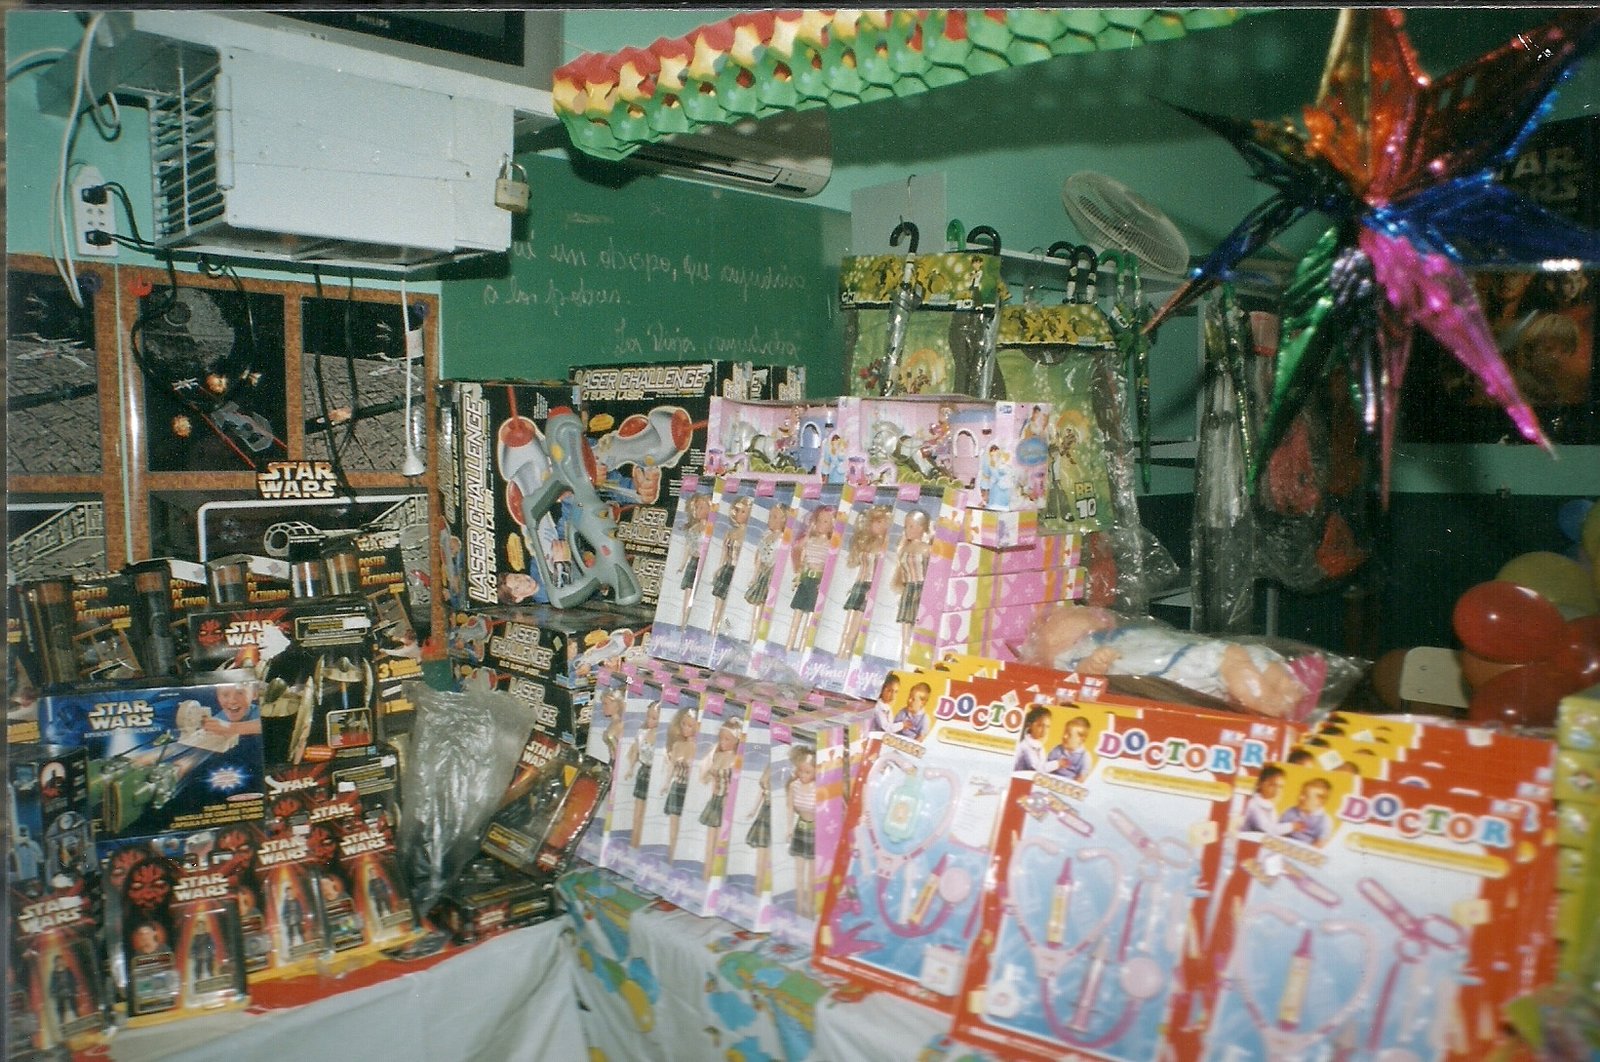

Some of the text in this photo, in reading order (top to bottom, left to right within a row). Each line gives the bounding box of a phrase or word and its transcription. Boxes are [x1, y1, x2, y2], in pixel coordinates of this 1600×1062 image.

[574, 369, 617, 391] LASER
[618, 365, 708, 390] CHALLENGE
[257, 461, 338, 481] STAR
[258, 480, 338, 499] WARS
[463, 396, 489, 603] LASER CHALLENGE
[1075, 498, 1097, 519] 10
[631, 507, 669, 529] LASER
[615, 521, 673, 547] CHALLENG
[359, 556, 386, 567] POSTER
[360, 567, 371, 577] DE
[71, 587, 110, 600] POSTER
[171, 588, 184, 600] DE
[73, 599, 88, 611] DE
[504, 621, 541, 645] LASER
[489, 636, 554, 671] CHALLENGE
[88, 700, 154, 717] STAR
[935, 692, 1025, 734] DOCTO
[89, 712, 155, 731] WARS
[1097, 727, 1238, 774] DOCTOR
[310, 802, 356, 821] STAR
[1336, 793, 1513, 848] DOCTOR
[339, 829, 385, 847] STAR
[258, 849, 308, 866] WARS
[341, 839, 387, 857] WARS
[173, 873, 229, 891] STAR
[174, 882, 230, 902] WARS
